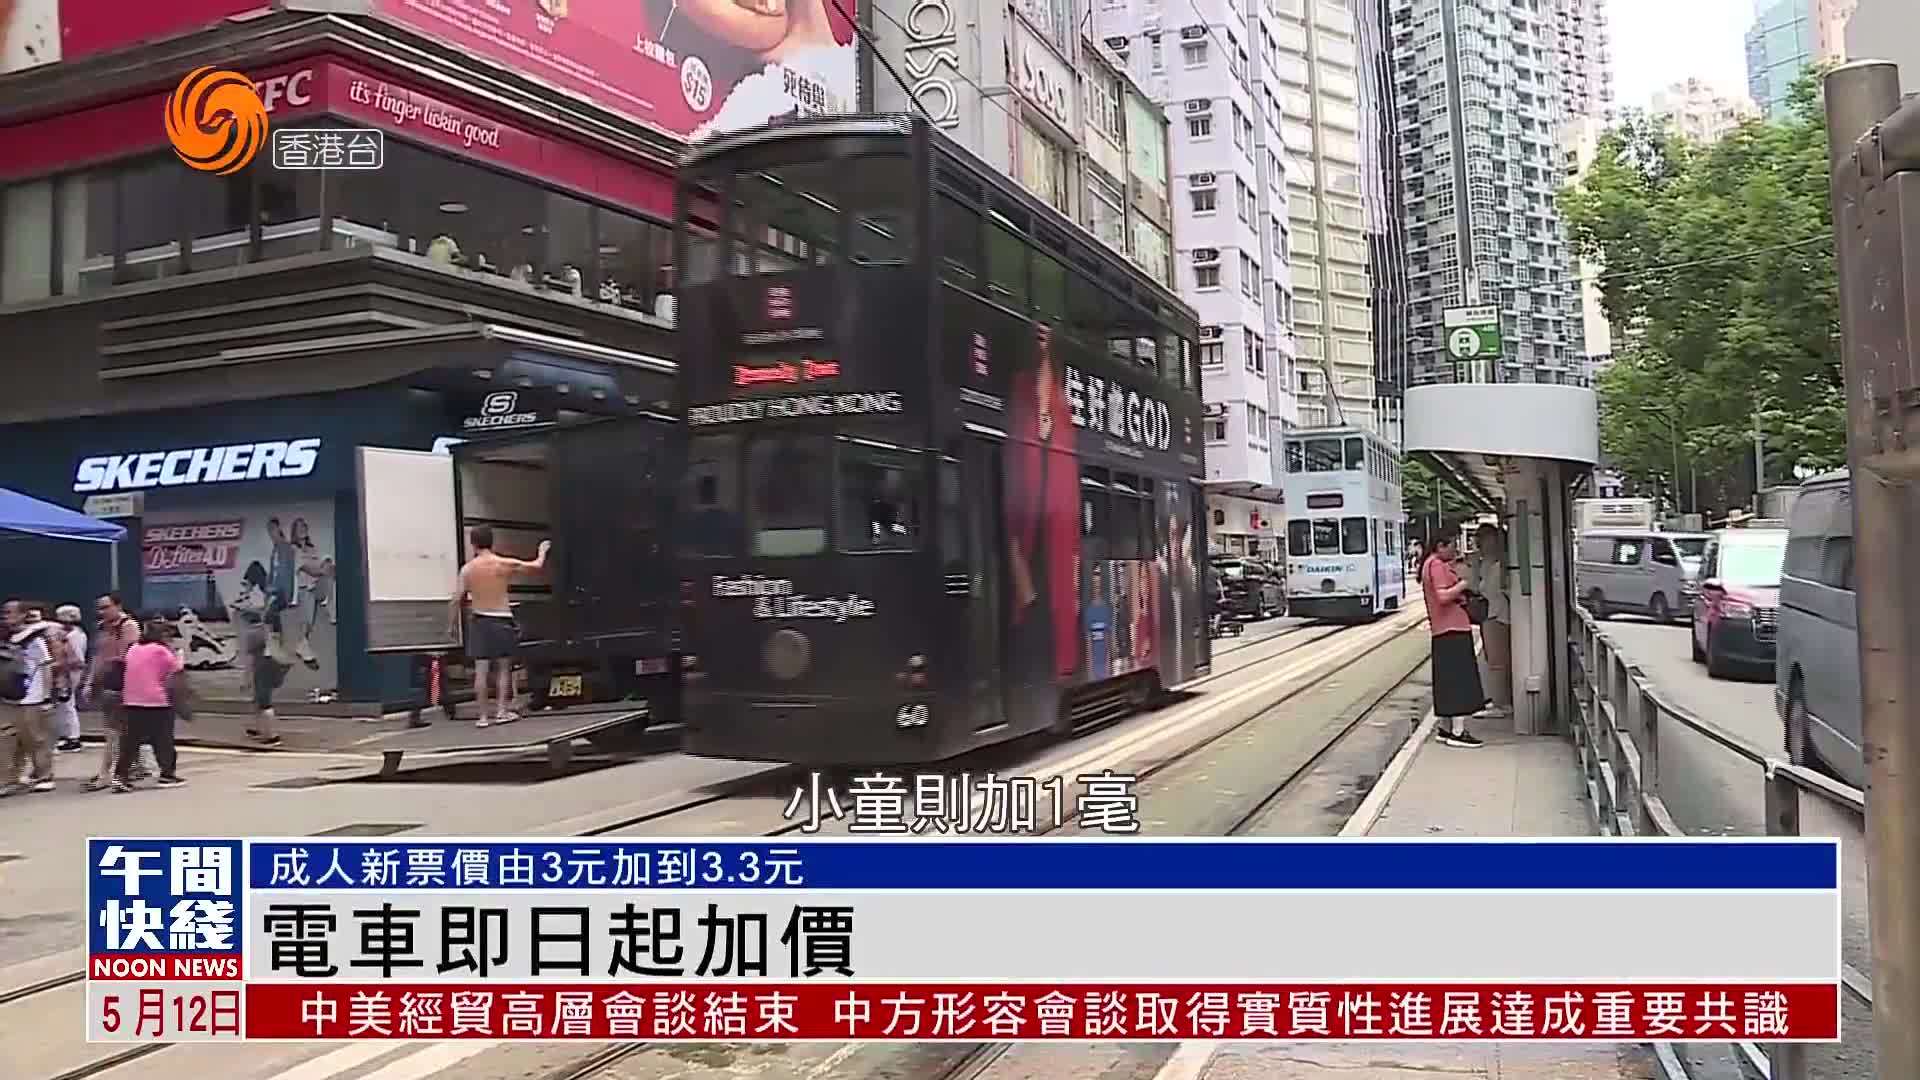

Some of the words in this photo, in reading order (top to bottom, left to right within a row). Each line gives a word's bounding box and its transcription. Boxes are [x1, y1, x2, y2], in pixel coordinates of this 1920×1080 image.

[255, 69, 313, 113] FC
[374, 83, 422, 123] finger
[768, 396, 832, 417] HONG
[834, 391, 903, 413] KONG
[464, 412, 536, 428] SKECHERS
[74, 439, 320, 492] SKECHERS
[146, 522, 241, 543] SKECHERS
[712, 575, 793, 597] Fashion
[753, 596, 774, 618] &
[775, 593, 876, 624] Lifestyle
[896, 704, 929, 728] 60
